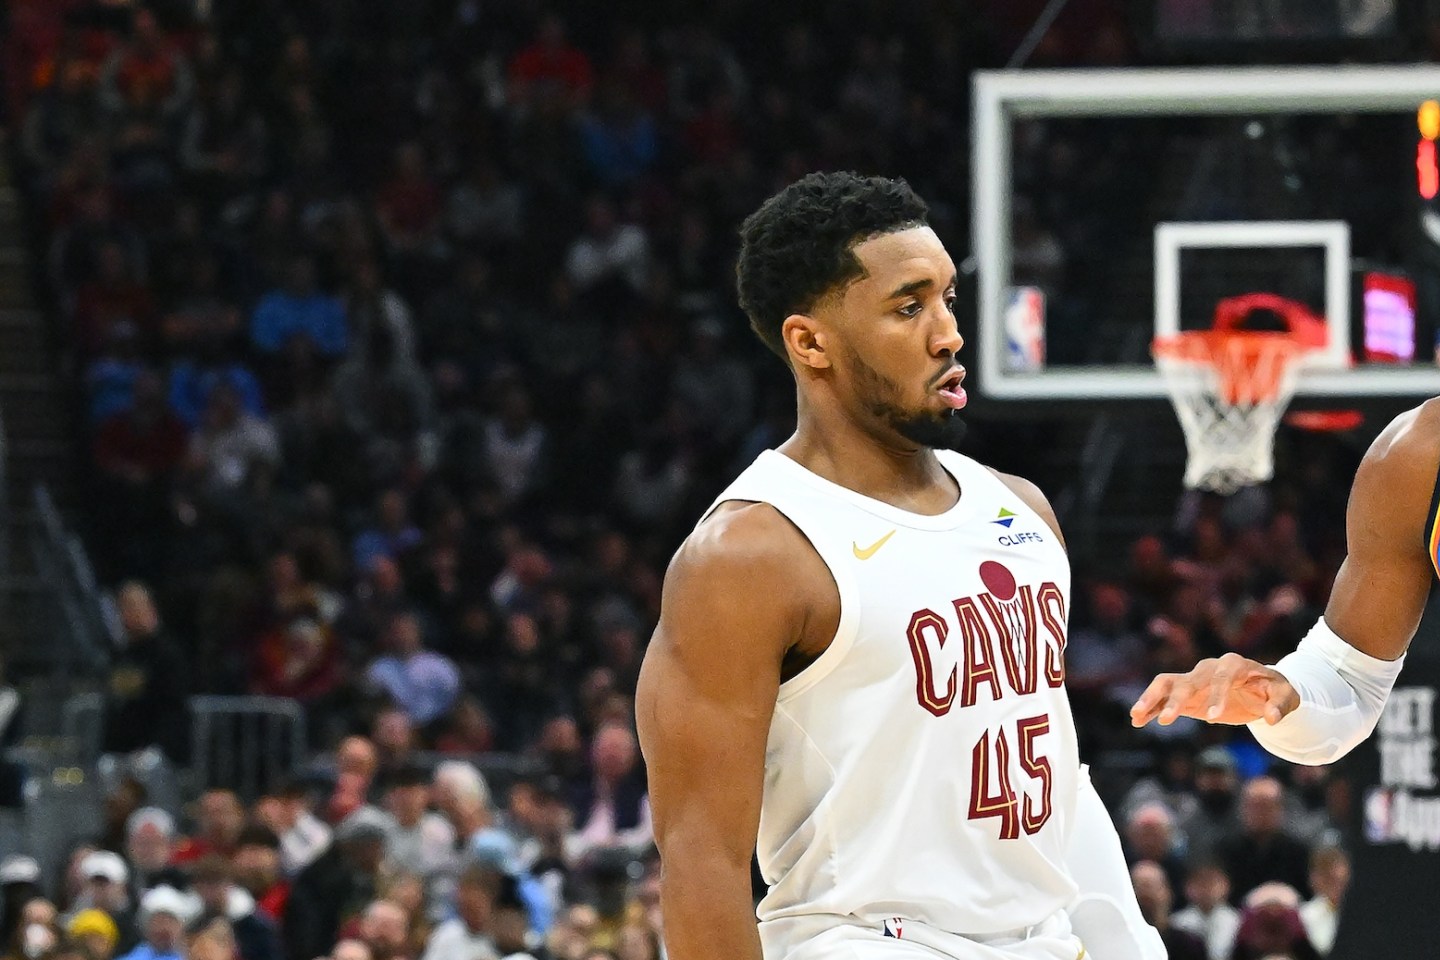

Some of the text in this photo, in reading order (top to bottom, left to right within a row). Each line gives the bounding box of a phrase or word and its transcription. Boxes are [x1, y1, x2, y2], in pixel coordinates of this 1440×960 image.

[998, 532, 1044, 547] CLIFFS
[906, 581, 1066, 718] CAVS
[968, 713, 1052, 840] 45
